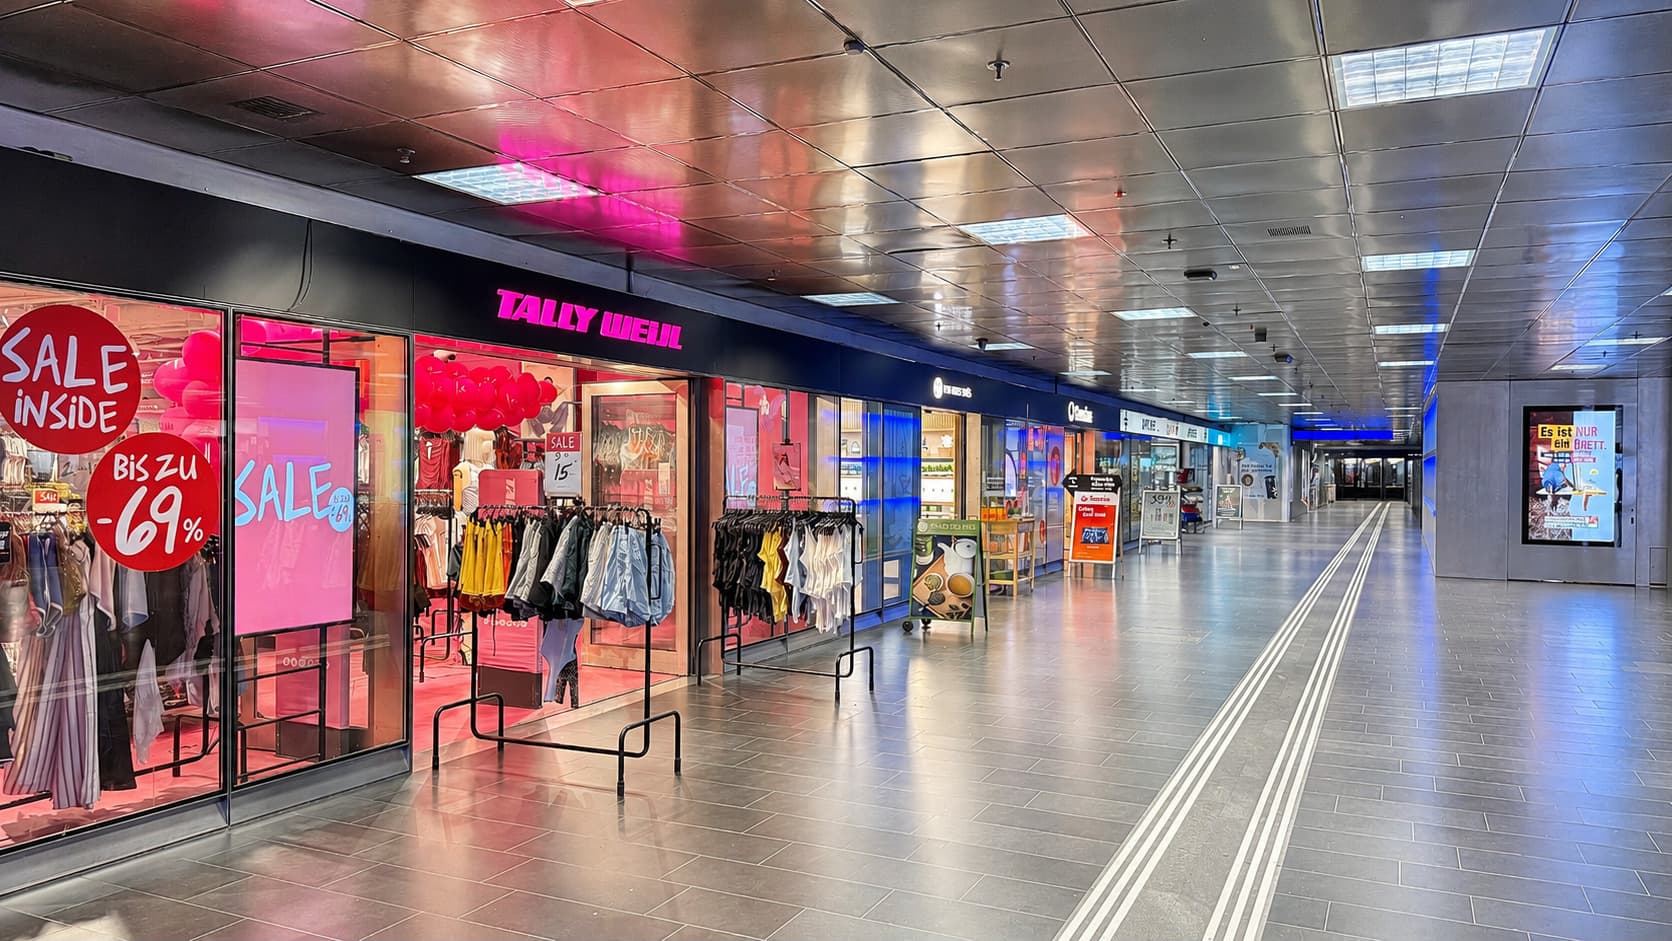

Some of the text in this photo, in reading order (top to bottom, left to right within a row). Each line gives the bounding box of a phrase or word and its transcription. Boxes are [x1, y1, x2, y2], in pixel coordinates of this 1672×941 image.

[496, 288, 598, 334] TALLY
[1, 326, 128, 394] SALE
[551, 436, 575, 449] SALE
[1541, 427, 1598, 437] Es ist NUR
[154, 454, 198, 481] ZU
[235, 459, 332, 526] SALE
